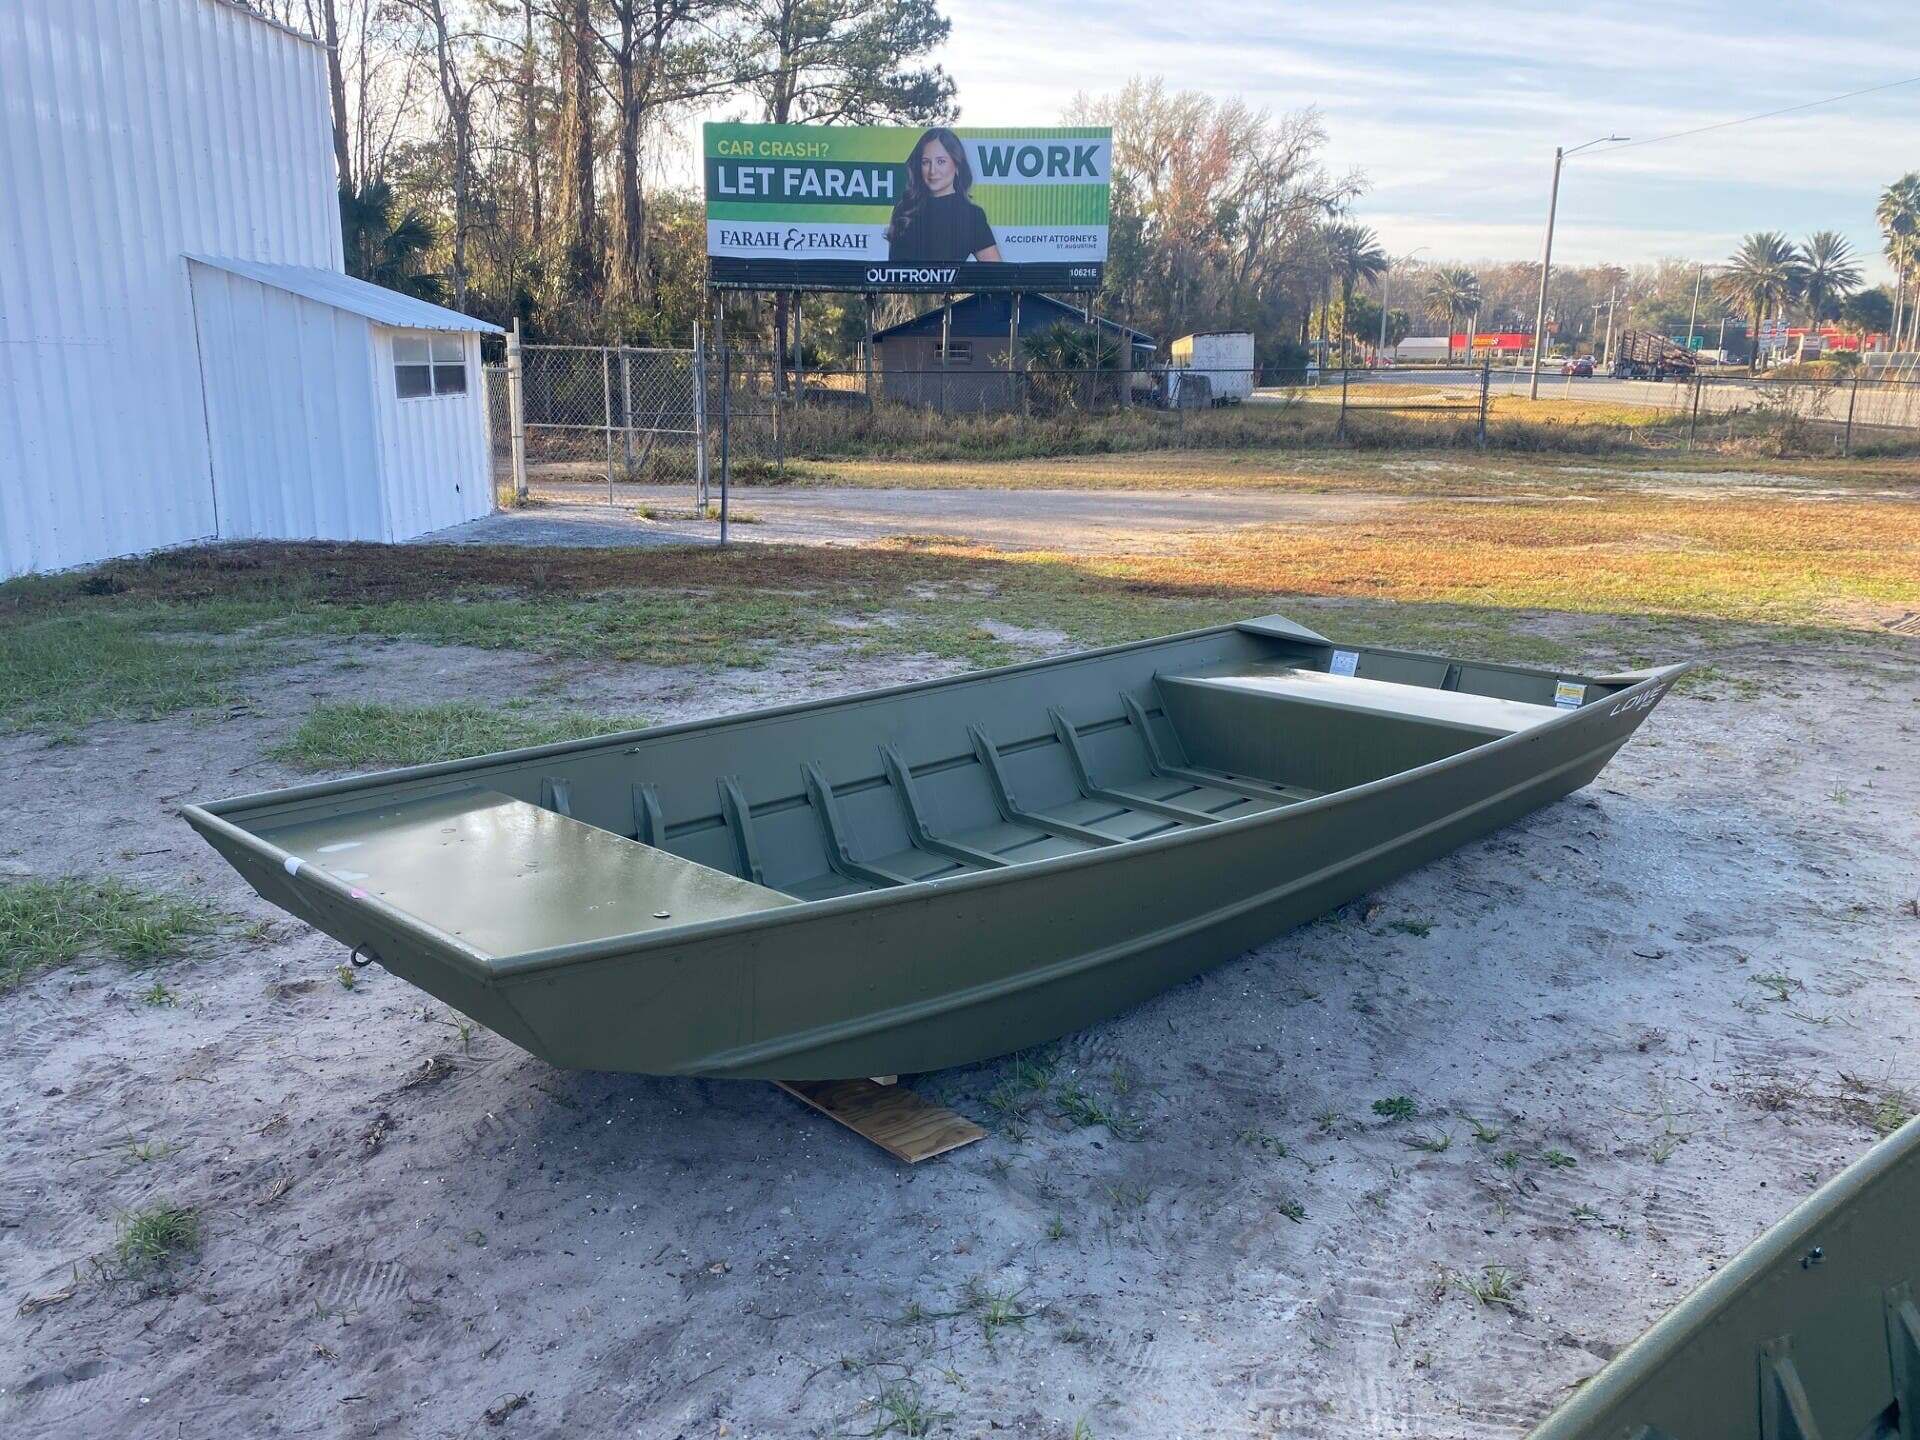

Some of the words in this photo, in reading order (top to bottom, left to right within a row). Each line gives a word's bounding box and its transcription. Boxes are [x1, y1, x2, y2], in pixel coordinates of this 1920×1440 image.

[717, 140, 754, 156] CAR
[758, 140, 830, 158] CRASH?
[977, 145, 1100, 178] WORK
[717, 166, 775, 195] LET
[783, 167, 894, 198] FARAH
[720, 230, 780, 247] FARAH
[783, 228, 805, 251] &
[808, 232, 868, 249] FARAH
[1005, 235, 1048, 244] ACCIDENT
[1048, 234, 1098, 243] ATTORNEYS
[1070, 268, 1097, 277] 10621E
